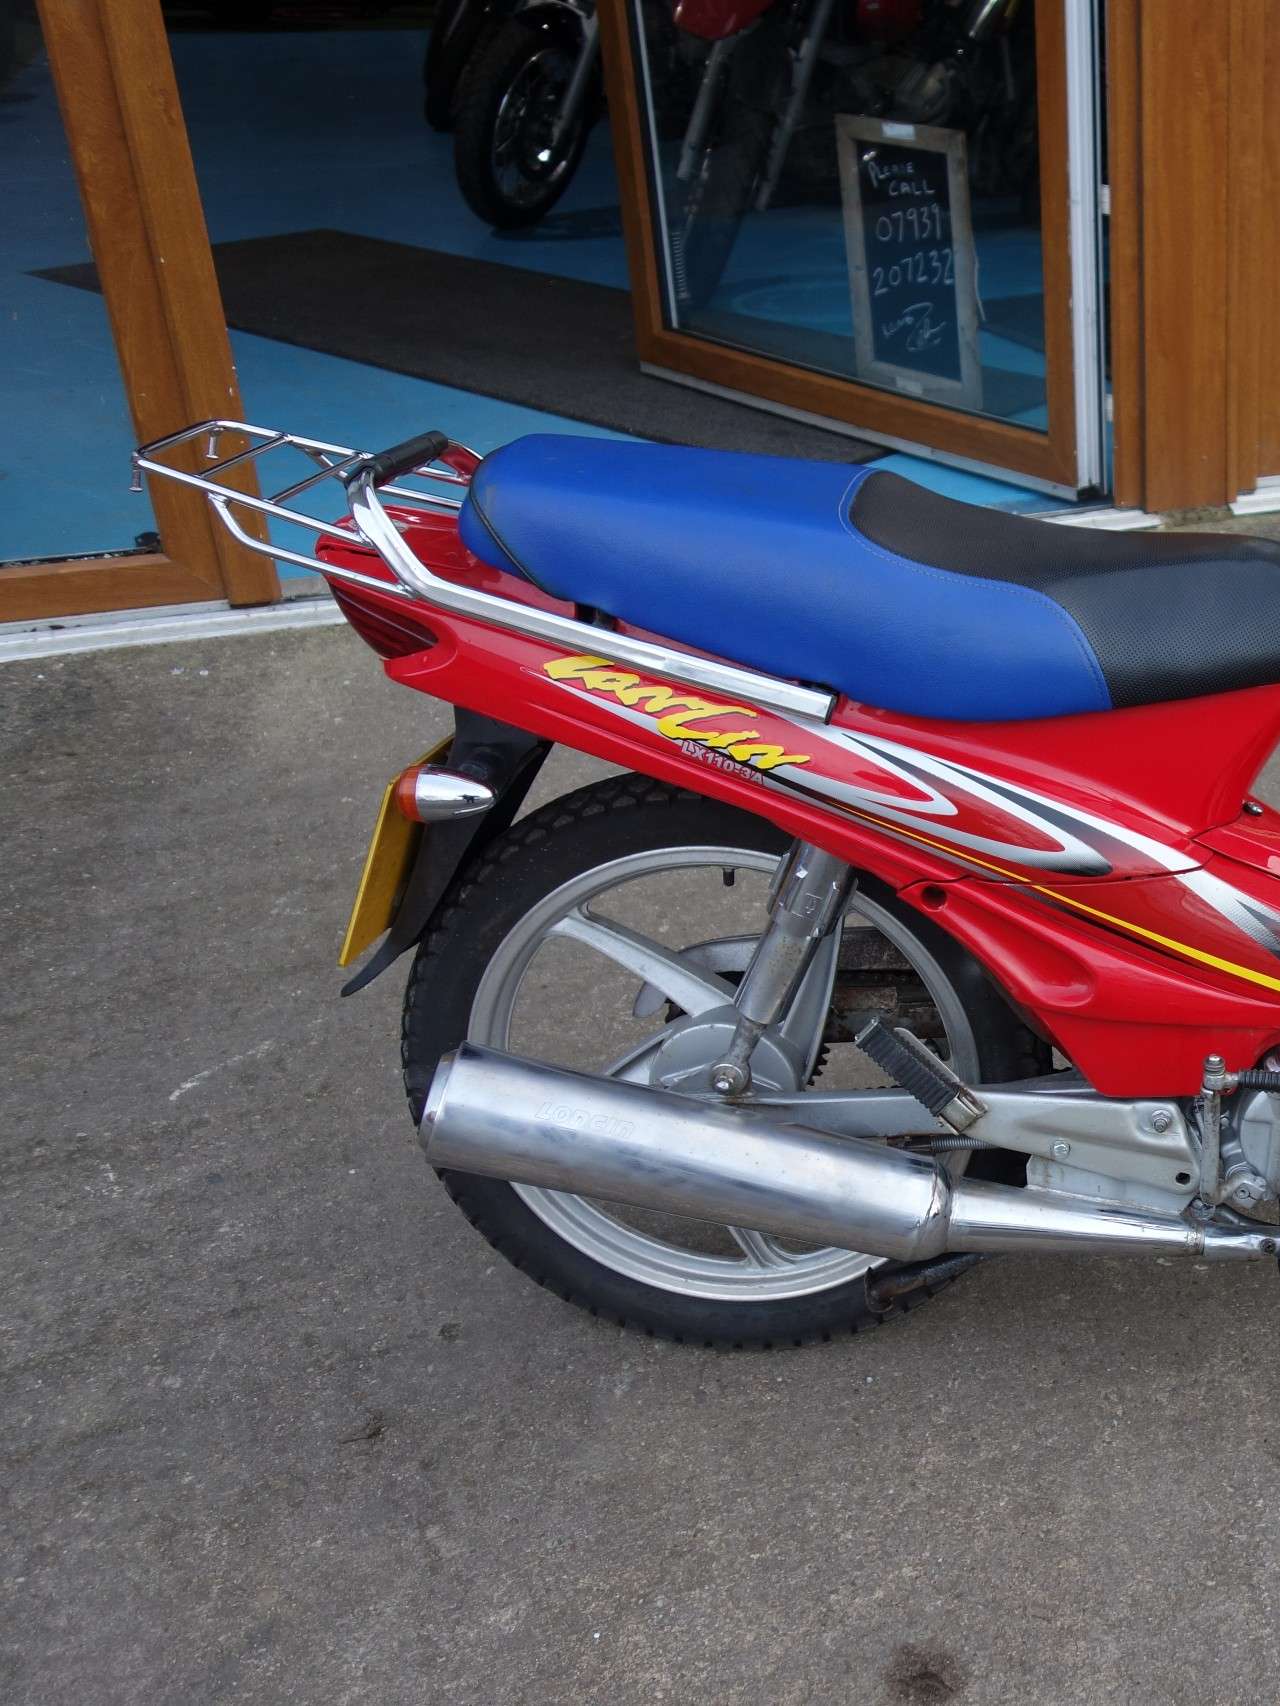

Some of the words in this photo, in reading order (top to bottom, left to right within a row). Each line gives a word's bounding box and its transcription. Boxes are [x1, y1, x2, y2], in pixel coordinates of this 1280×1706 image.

[889, 180, 936, 197] CALL
[876, 203, 942, 243] 07939
[873, 249, 956, 295] 207232
